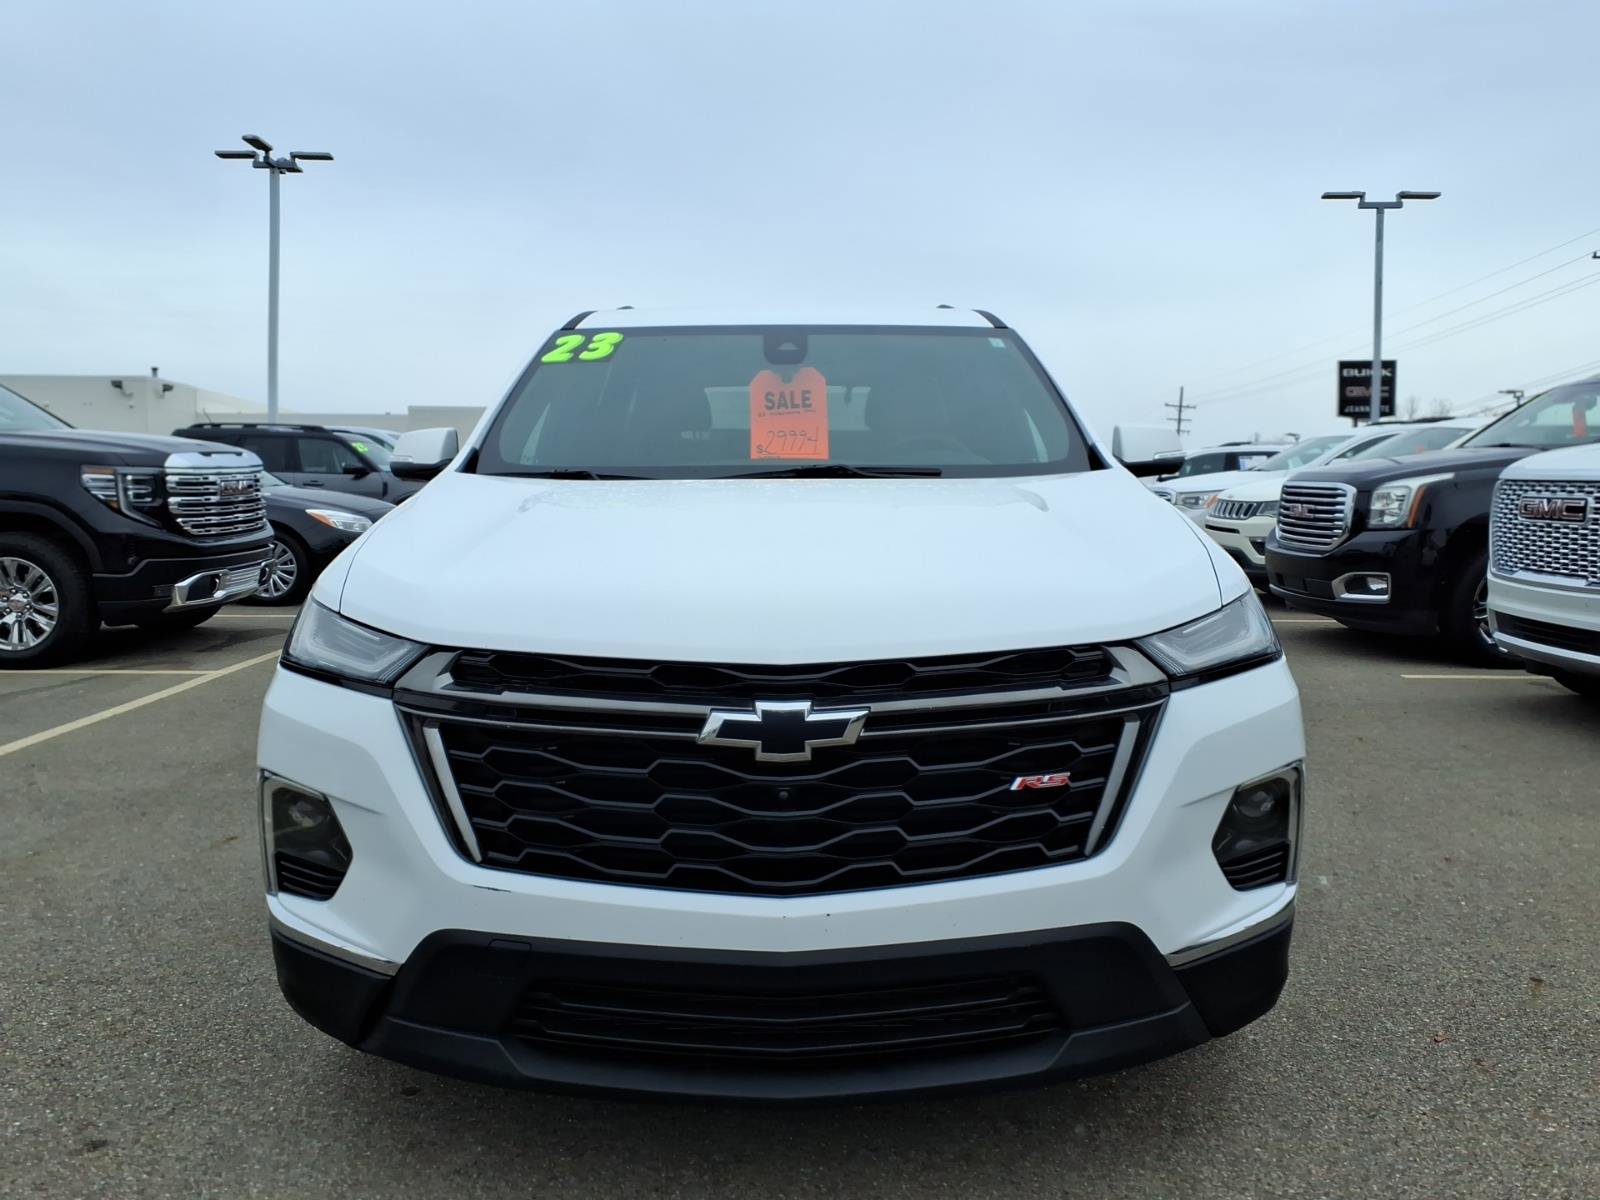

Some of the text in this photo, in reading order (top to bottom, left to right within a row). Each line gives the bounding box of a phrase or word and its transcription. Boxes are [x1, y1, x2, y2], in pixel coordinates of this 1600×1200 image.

[541, 332, 624, 363] 23
[1342, 367, 1392, 377] BUIK
[764, 390, 812, 410] SALE
[1520, 498, 1586, 520] GMC
[1010, 771, 1071, 790] RS
